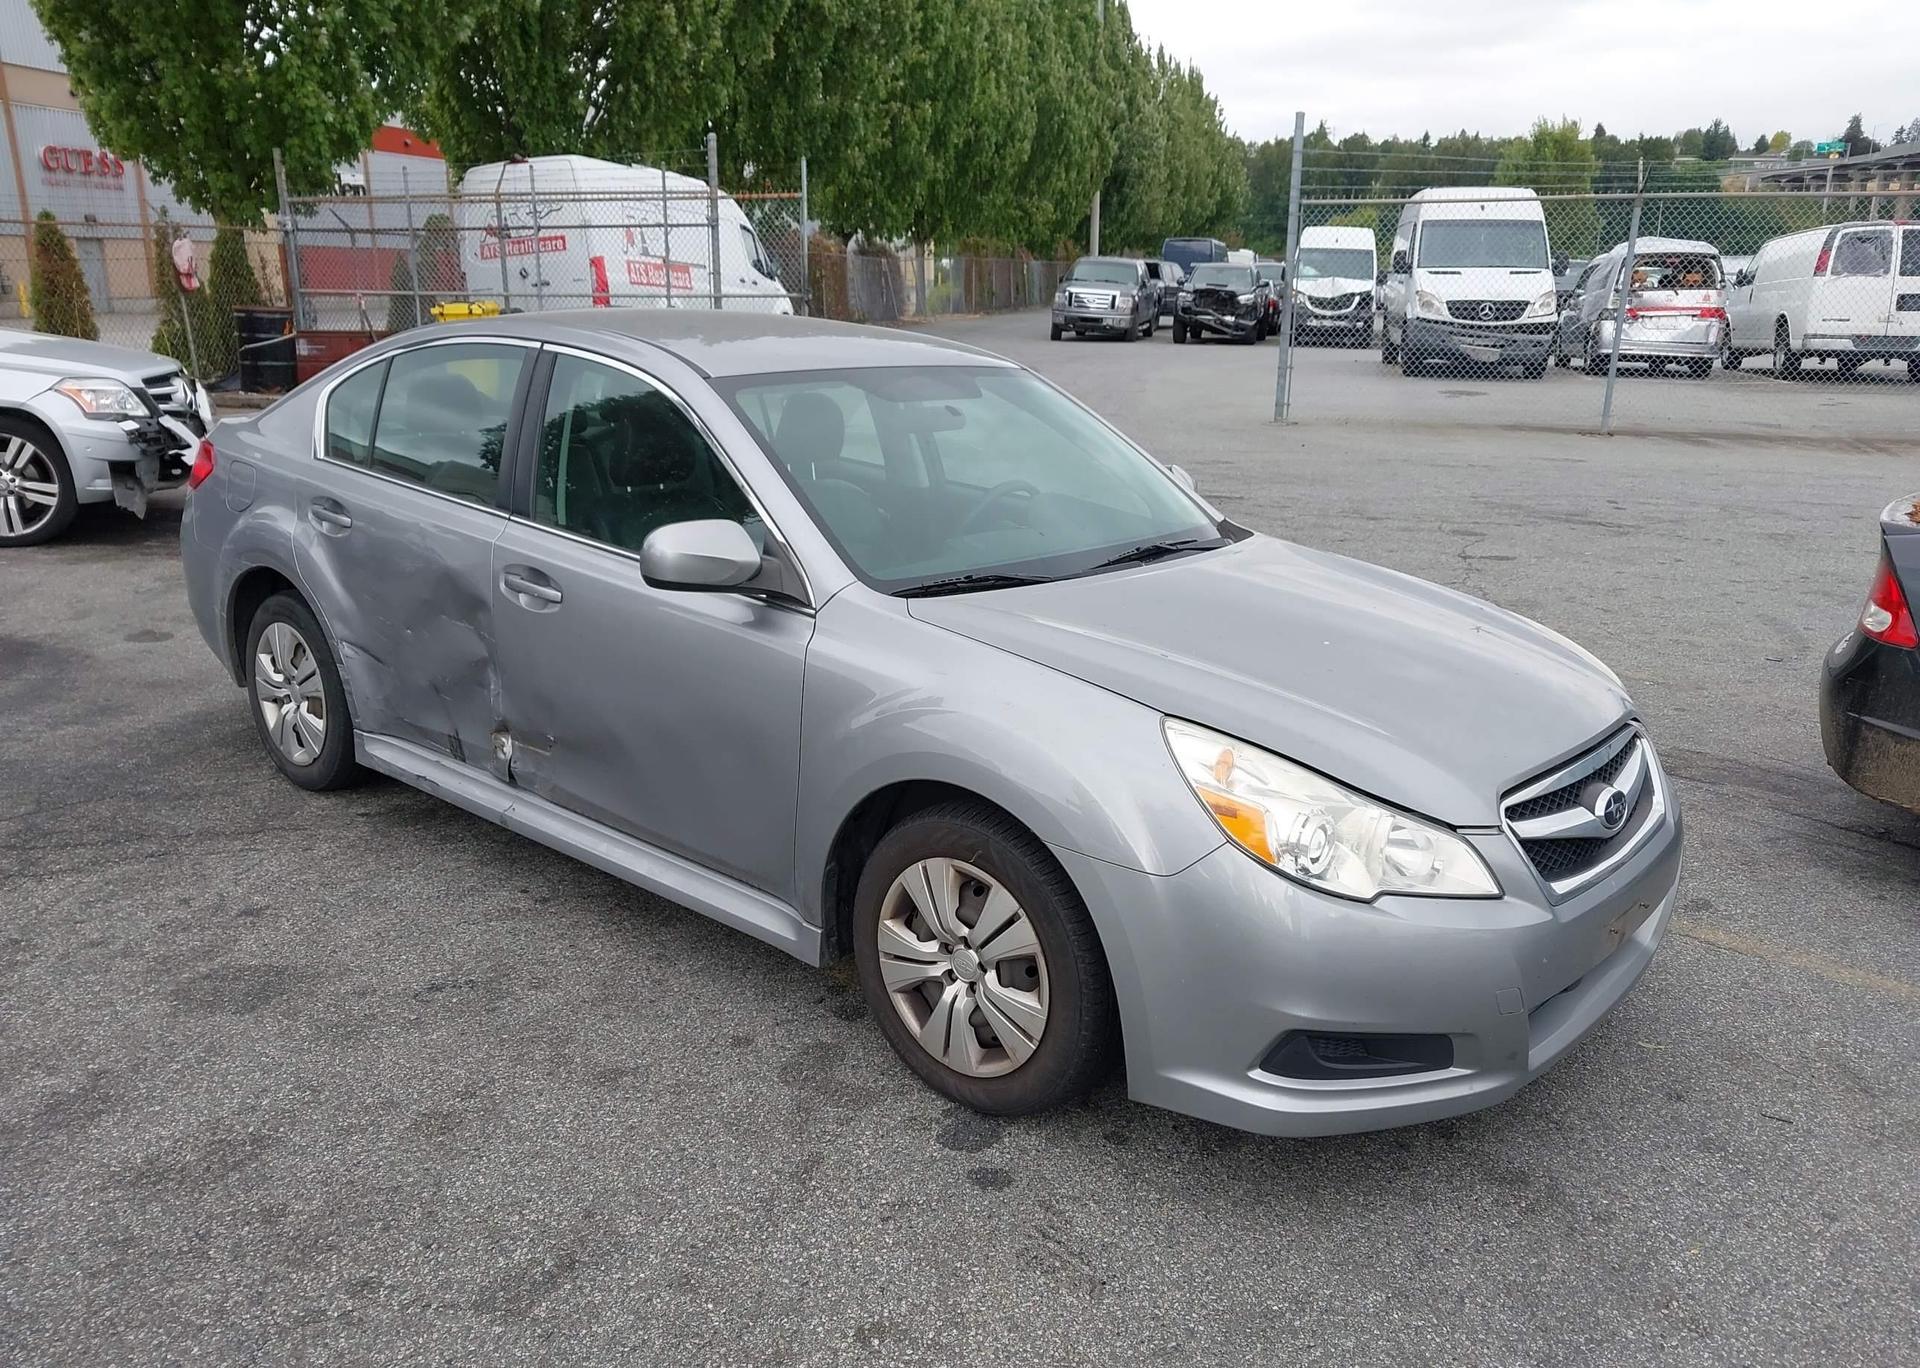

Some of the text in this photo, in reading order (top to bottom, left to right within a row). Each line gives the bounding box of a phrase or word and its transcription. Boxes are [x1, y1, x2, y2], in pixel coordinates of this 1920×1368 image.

[42, 145, 124, 177] GUESS
[483, 244, 501, 258] ATS
[630, 262, 647, 284] ATS
